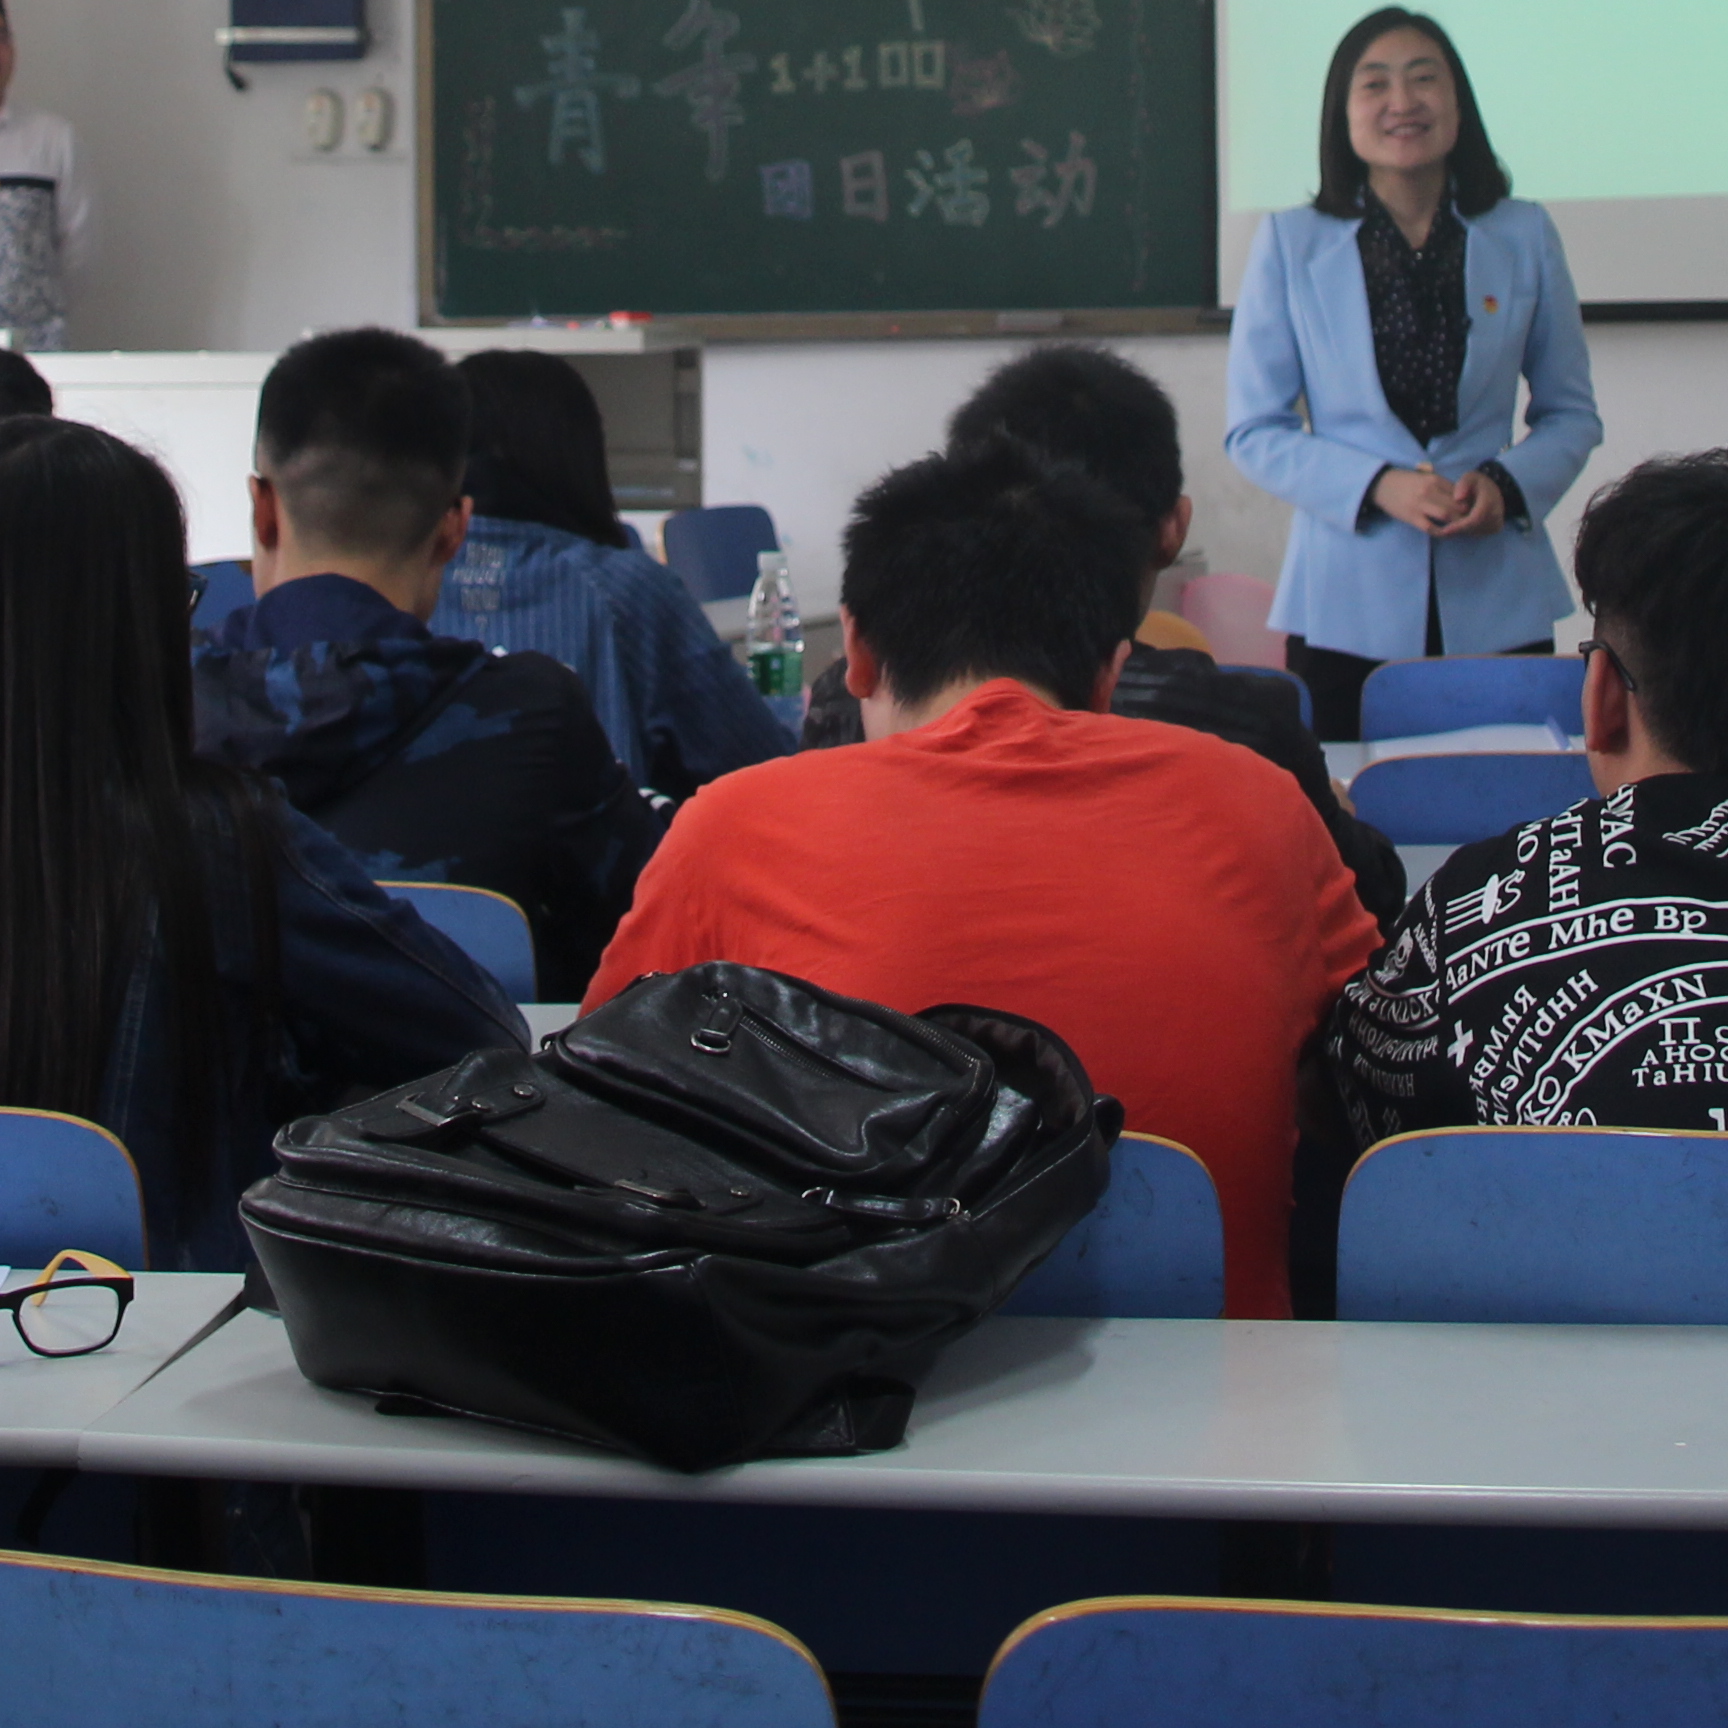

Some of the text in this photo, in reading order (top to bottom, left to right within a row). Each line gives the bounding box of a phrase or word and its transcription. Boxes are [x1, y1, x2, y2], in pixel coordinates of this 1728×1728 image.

[760, 130, 1098, 229] 团日活动
[1548, 907, 1635, 950] Mhe
